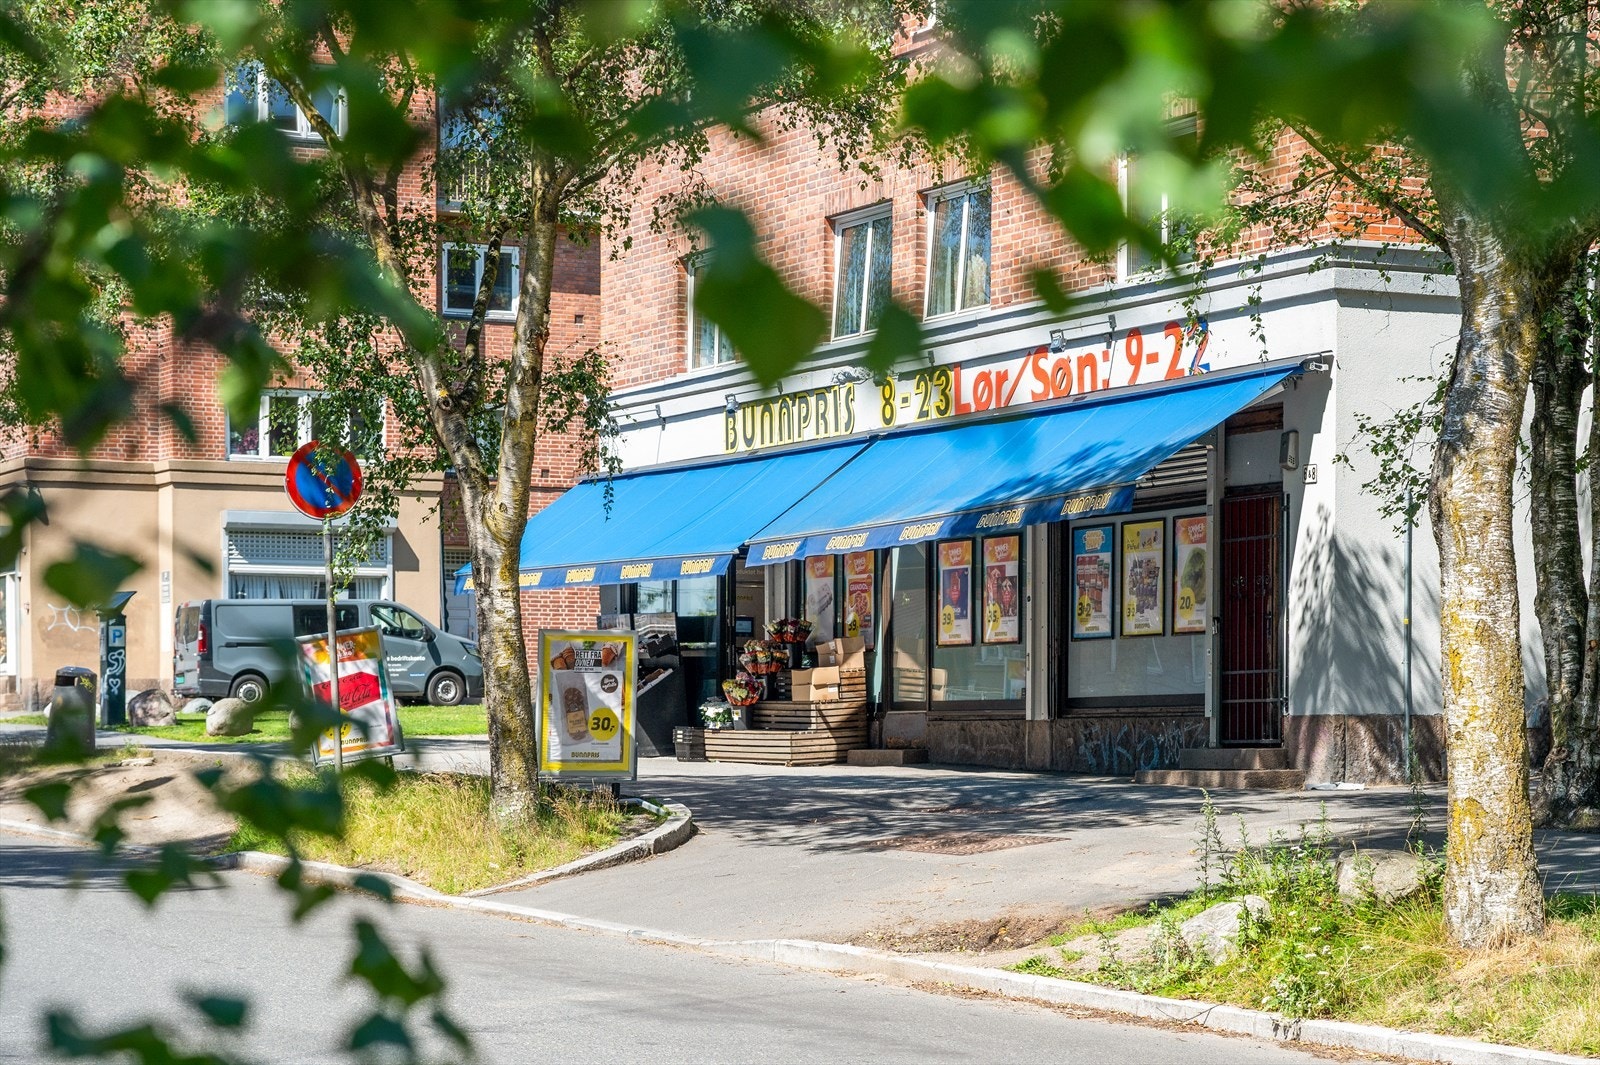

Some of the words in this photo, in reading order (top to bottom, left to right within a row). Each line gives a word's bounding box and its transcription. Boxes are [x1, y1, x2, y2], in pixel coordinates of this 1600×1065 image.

[724, 382, 855, 453] BUNNPRIS
[112, 629, 123, 643] P
[575, 651, 589, 659] RETT
[591, 651, 602, 659] FRA
